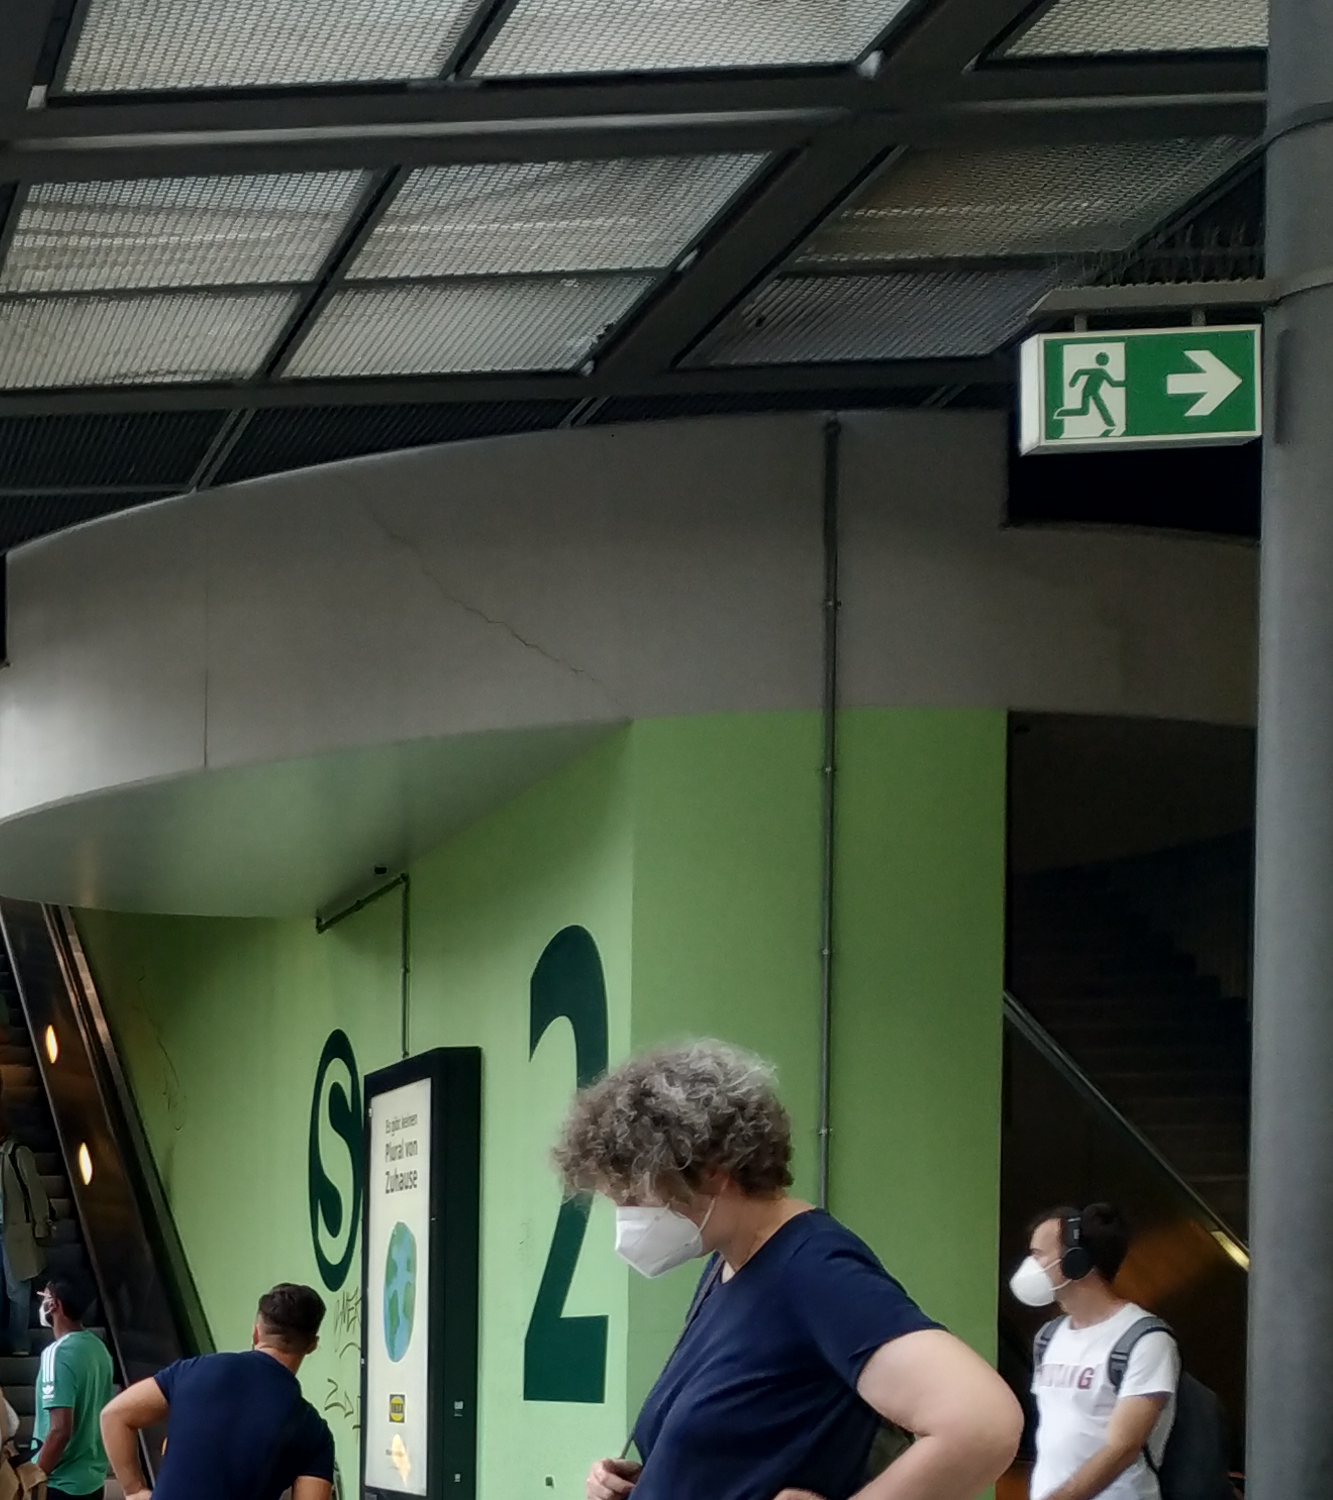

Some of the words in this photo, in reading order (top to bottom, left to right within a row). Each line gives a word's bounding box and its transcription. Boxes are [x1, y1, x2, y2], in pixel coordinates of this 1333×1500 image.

[385, 1138, 404, 1163] Plural
[524, 925, 609, 1403] 2
[385, 1167, 418, 1194] Zuhause
